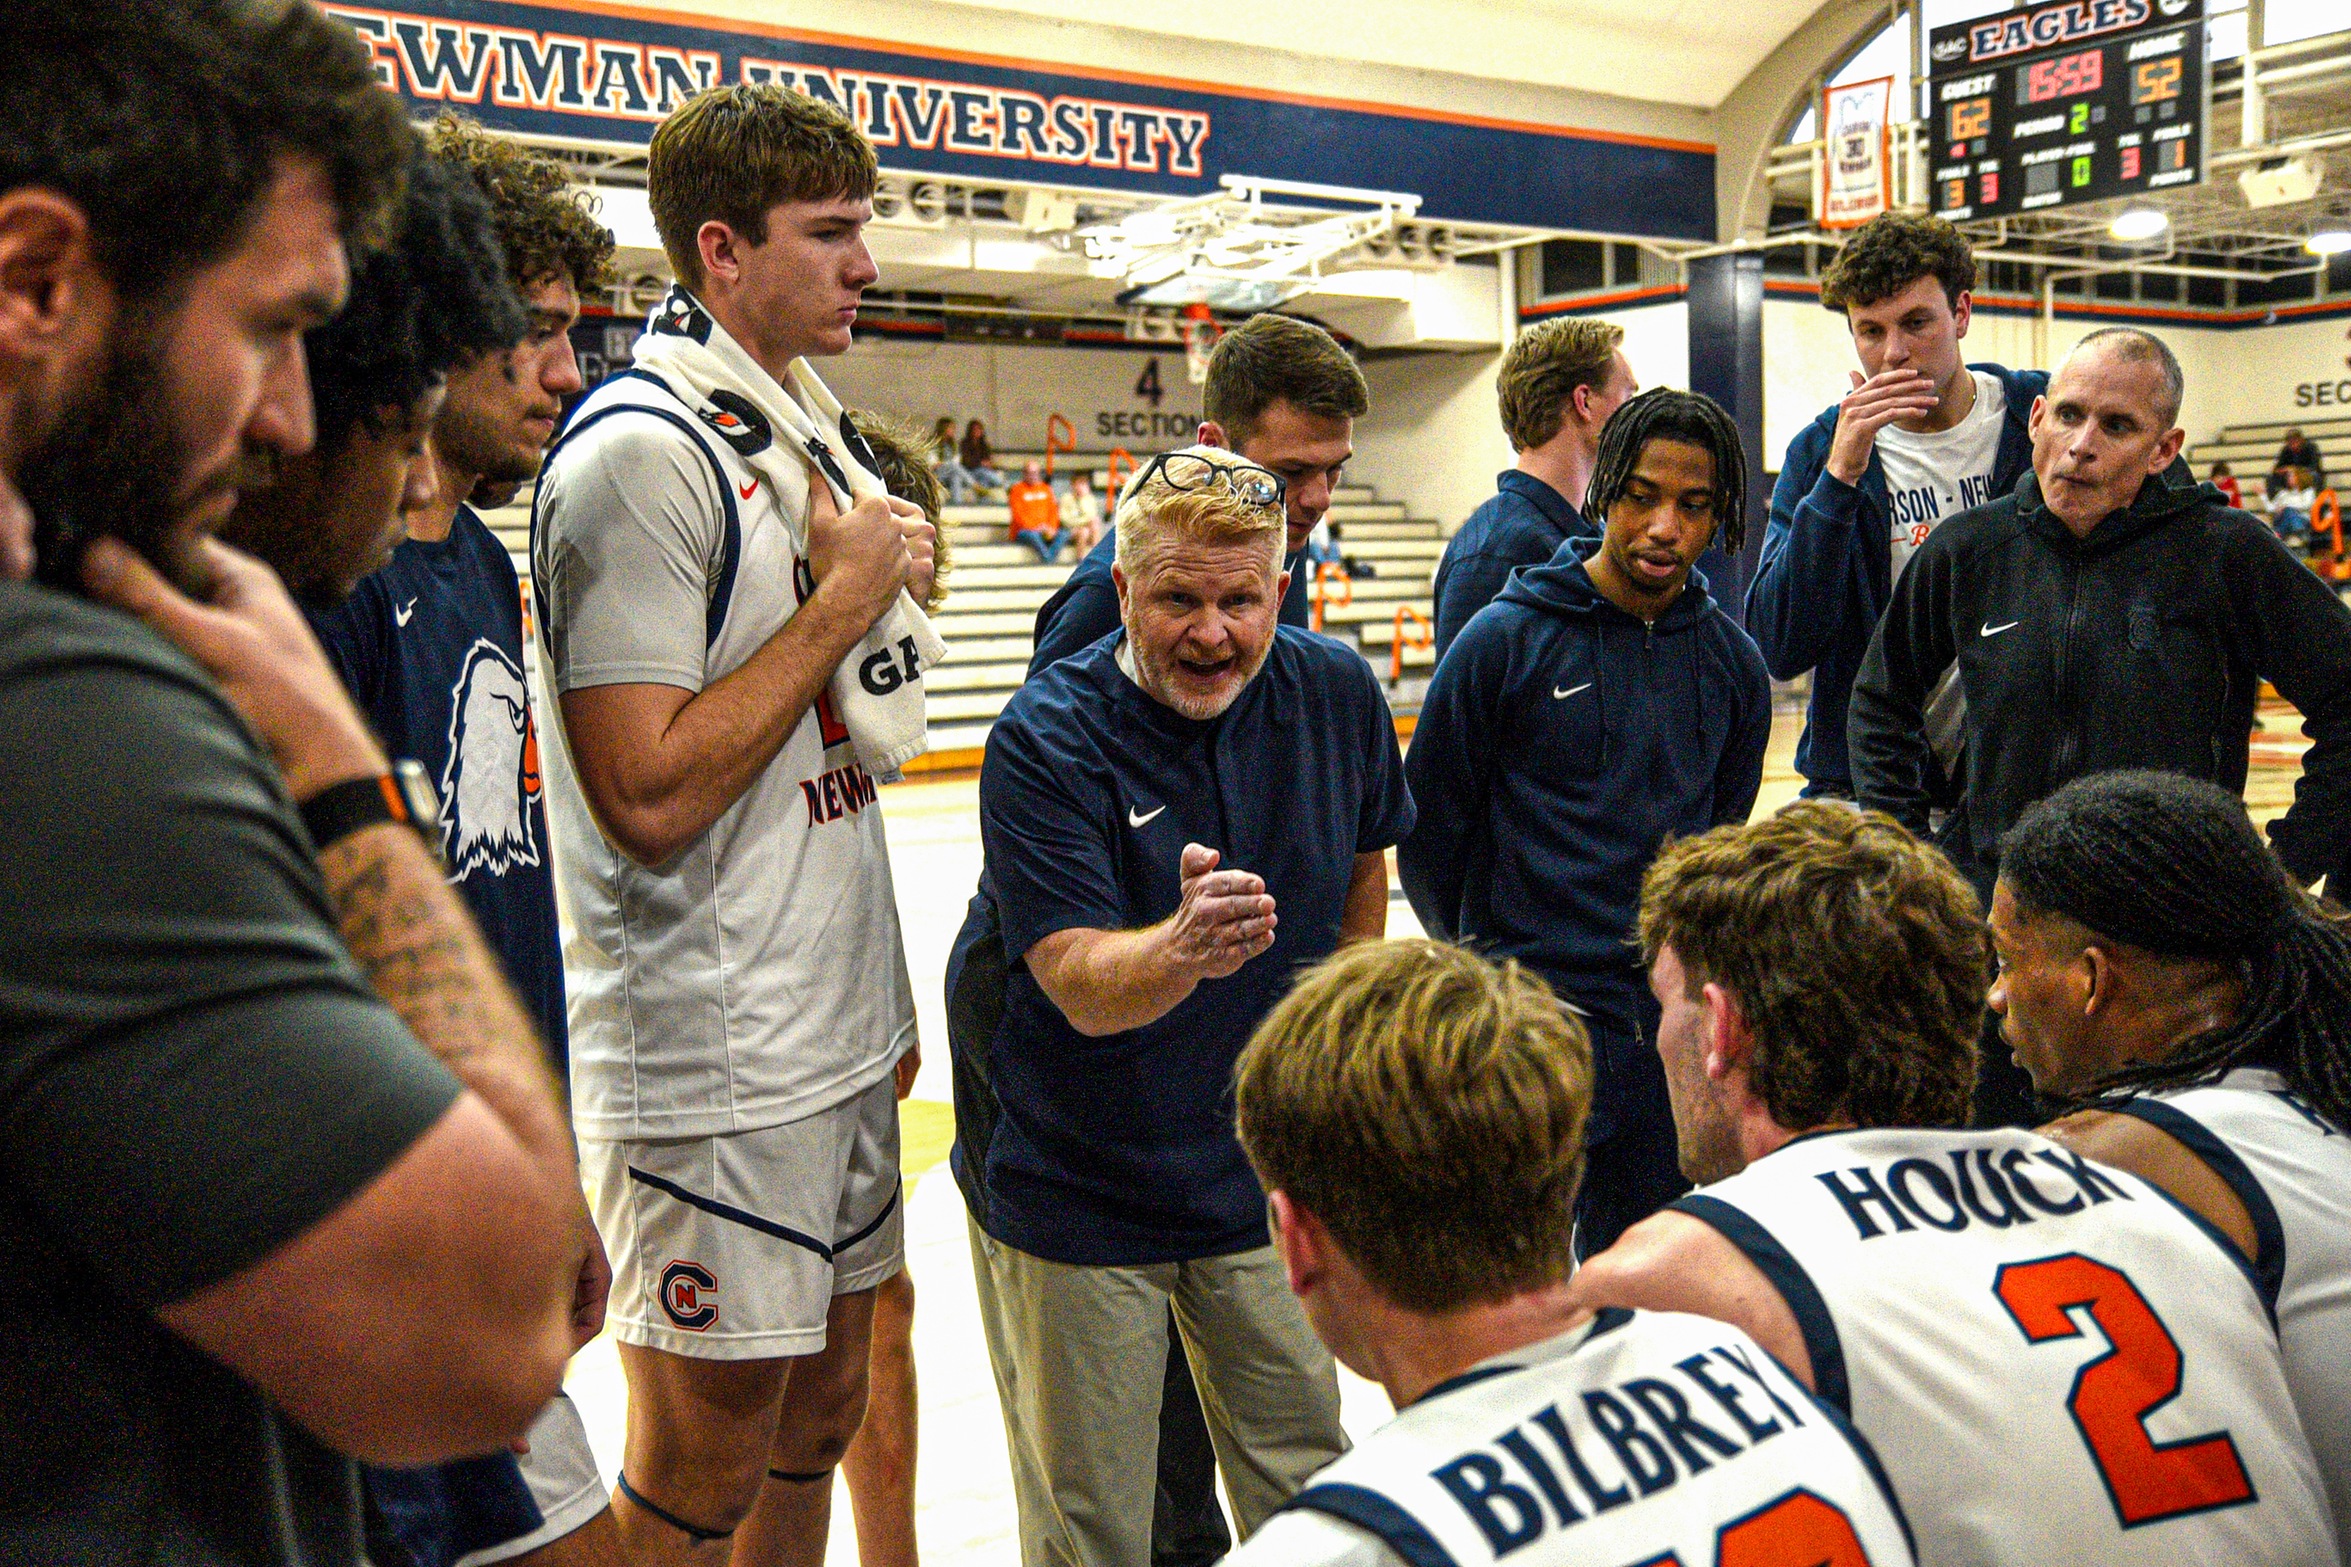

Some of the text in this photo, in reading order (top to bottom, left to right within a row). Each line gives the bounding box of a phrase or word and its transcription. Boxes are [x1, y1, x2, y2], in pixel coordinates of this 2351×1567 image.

[1969, 0, 2151, 62] EAGLES
[1941, 73, 1997, 101] GUEST
[2137, 57, 2182, 103] 52
[740, 57, 1208, 176] NIVERSITY
[1951, 99, 1991, 140] 62
[2070, 102, 2089, 134] 2
[2121, 147, 2140, 180] 3
[1948, 179, 1965, 209] 3
[1981, 173, 1998, 203] 3
[1136, 358, 1164, 406] 4
[2295, 380, 2351, 407] SEC
[1096, 410, 1204, 438] SECTION
[1813, 1147, 2137, 1241] HOUCK
[1990, 1251, 2262, 1531] 2
[1428, 1343, 1807, 1562] BILBREY
